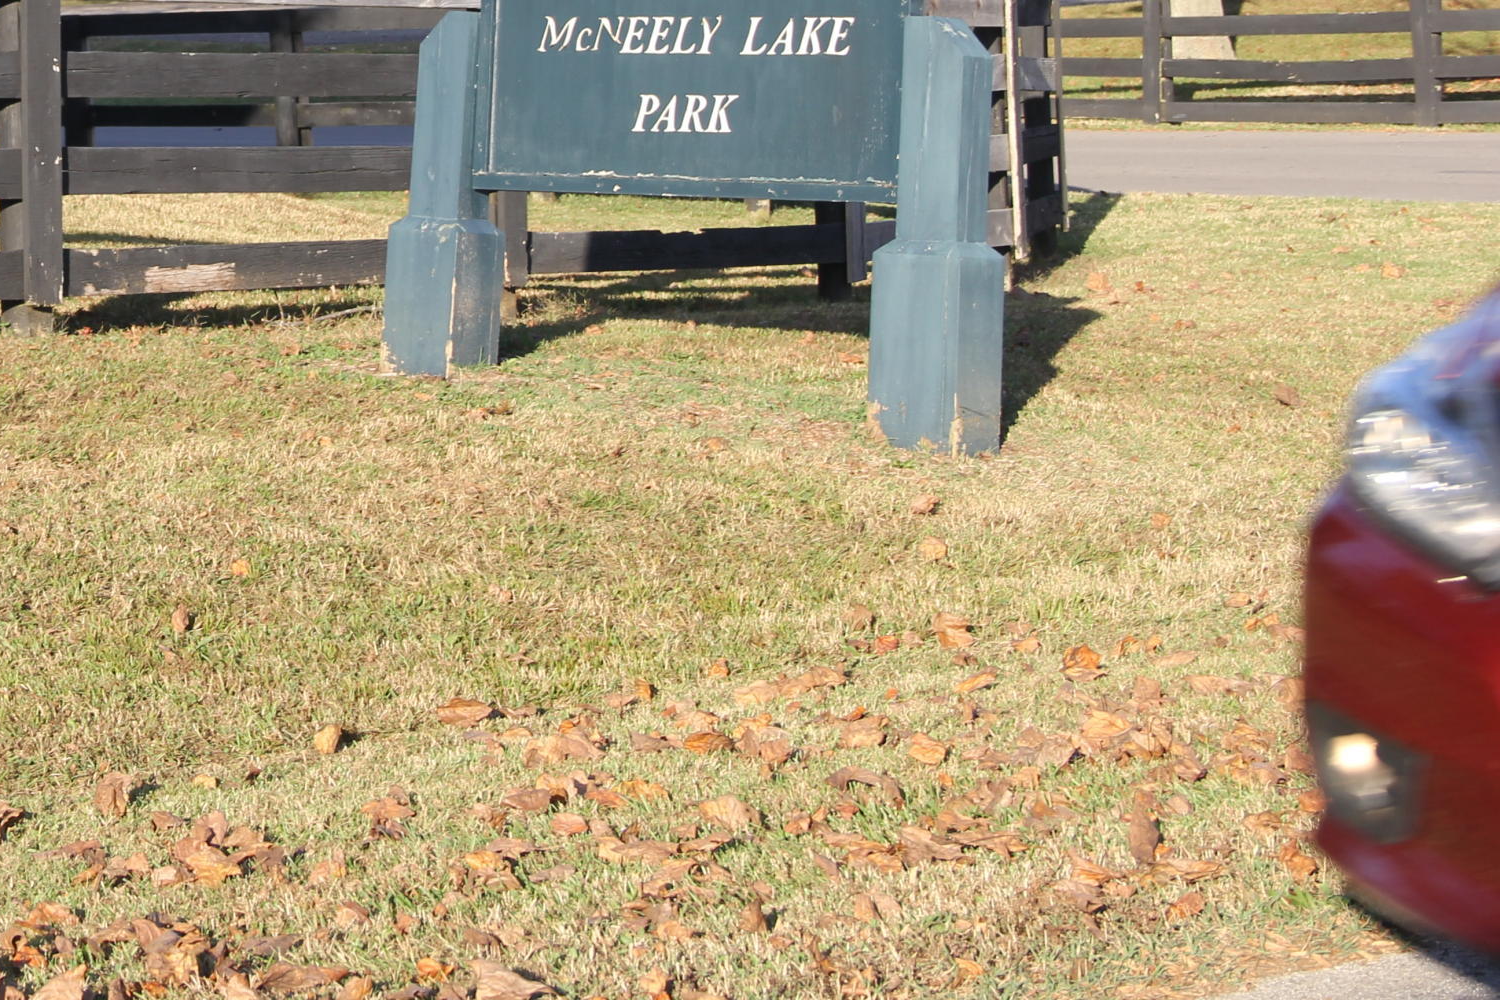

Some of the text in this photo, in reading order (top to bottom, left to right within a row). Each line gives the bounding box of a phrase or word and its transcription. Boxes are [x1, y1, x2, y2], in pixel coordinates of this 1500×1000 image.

[537, 15, 855, 56] McNEELY LAKE
[631, 93, 740, 133] PARK
